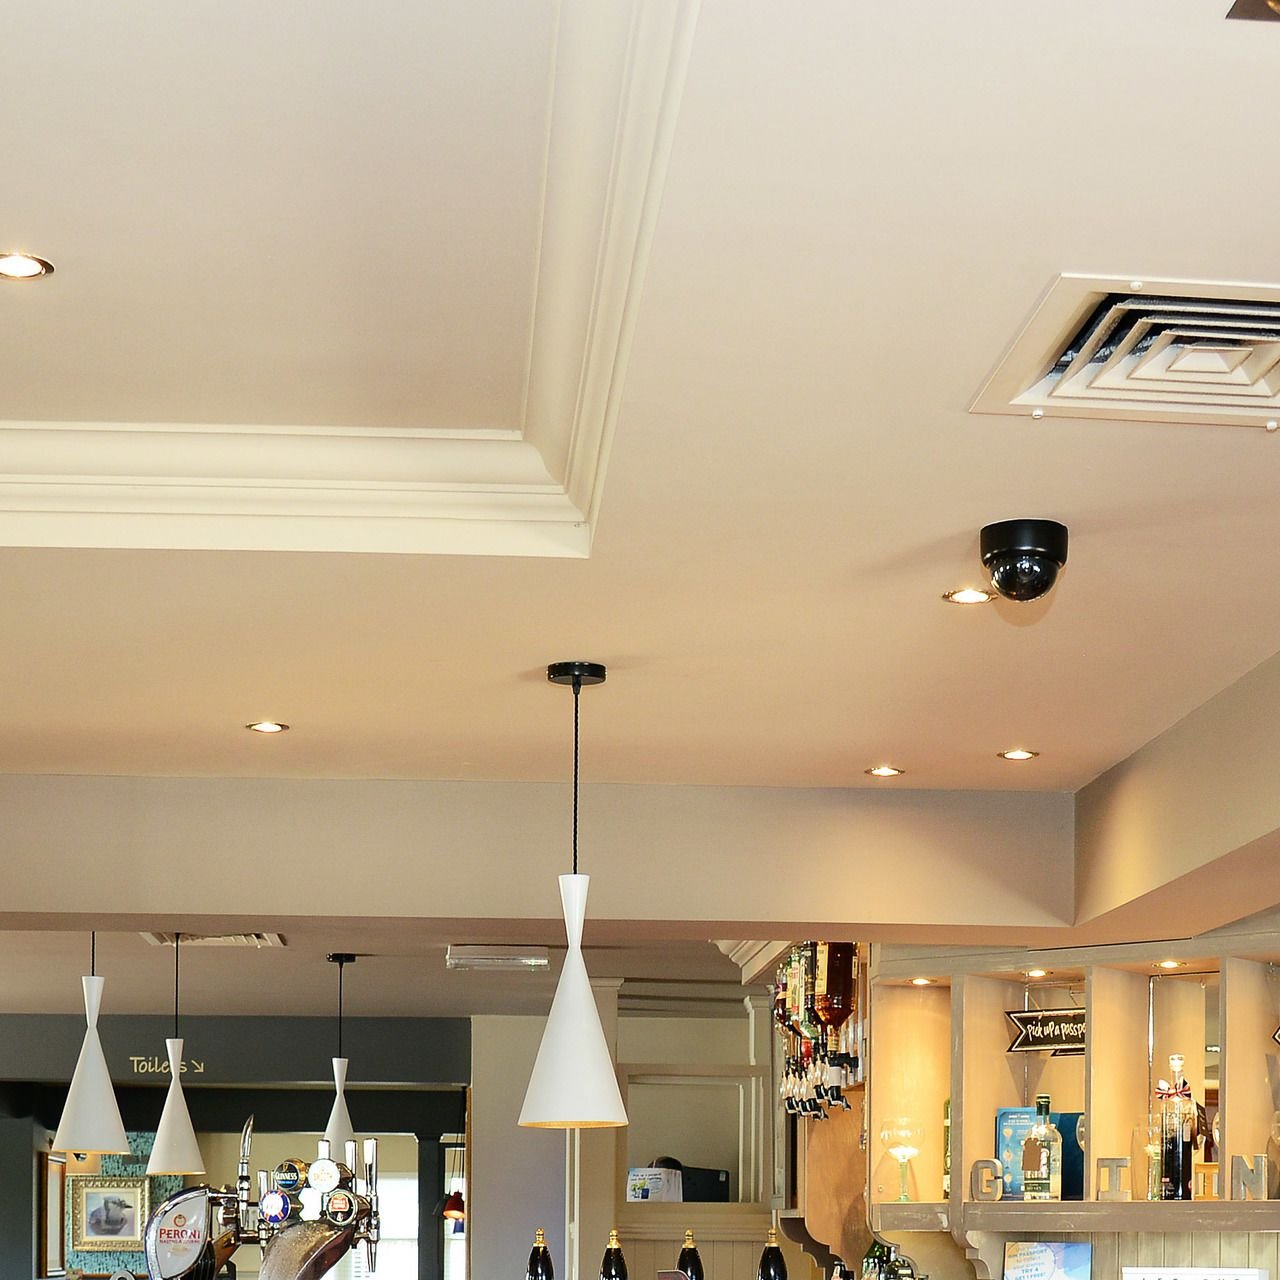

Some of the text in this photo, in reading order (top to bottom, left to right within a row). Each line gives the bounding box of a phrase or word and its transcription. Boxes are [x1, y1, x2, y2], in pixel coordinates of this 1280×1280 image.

[1027, 1020, 1043, 1042] pick
[1054, 1025, 1060, 1036] a
[129, 1056, 188, 1073] Toiles
[970, 1158, 1003, 1201] G
[1097, 1157, 1132, 1200] I
[1231, 1154, 1268, 1200] N
[159, 1228, 200, 1239] PERONI
